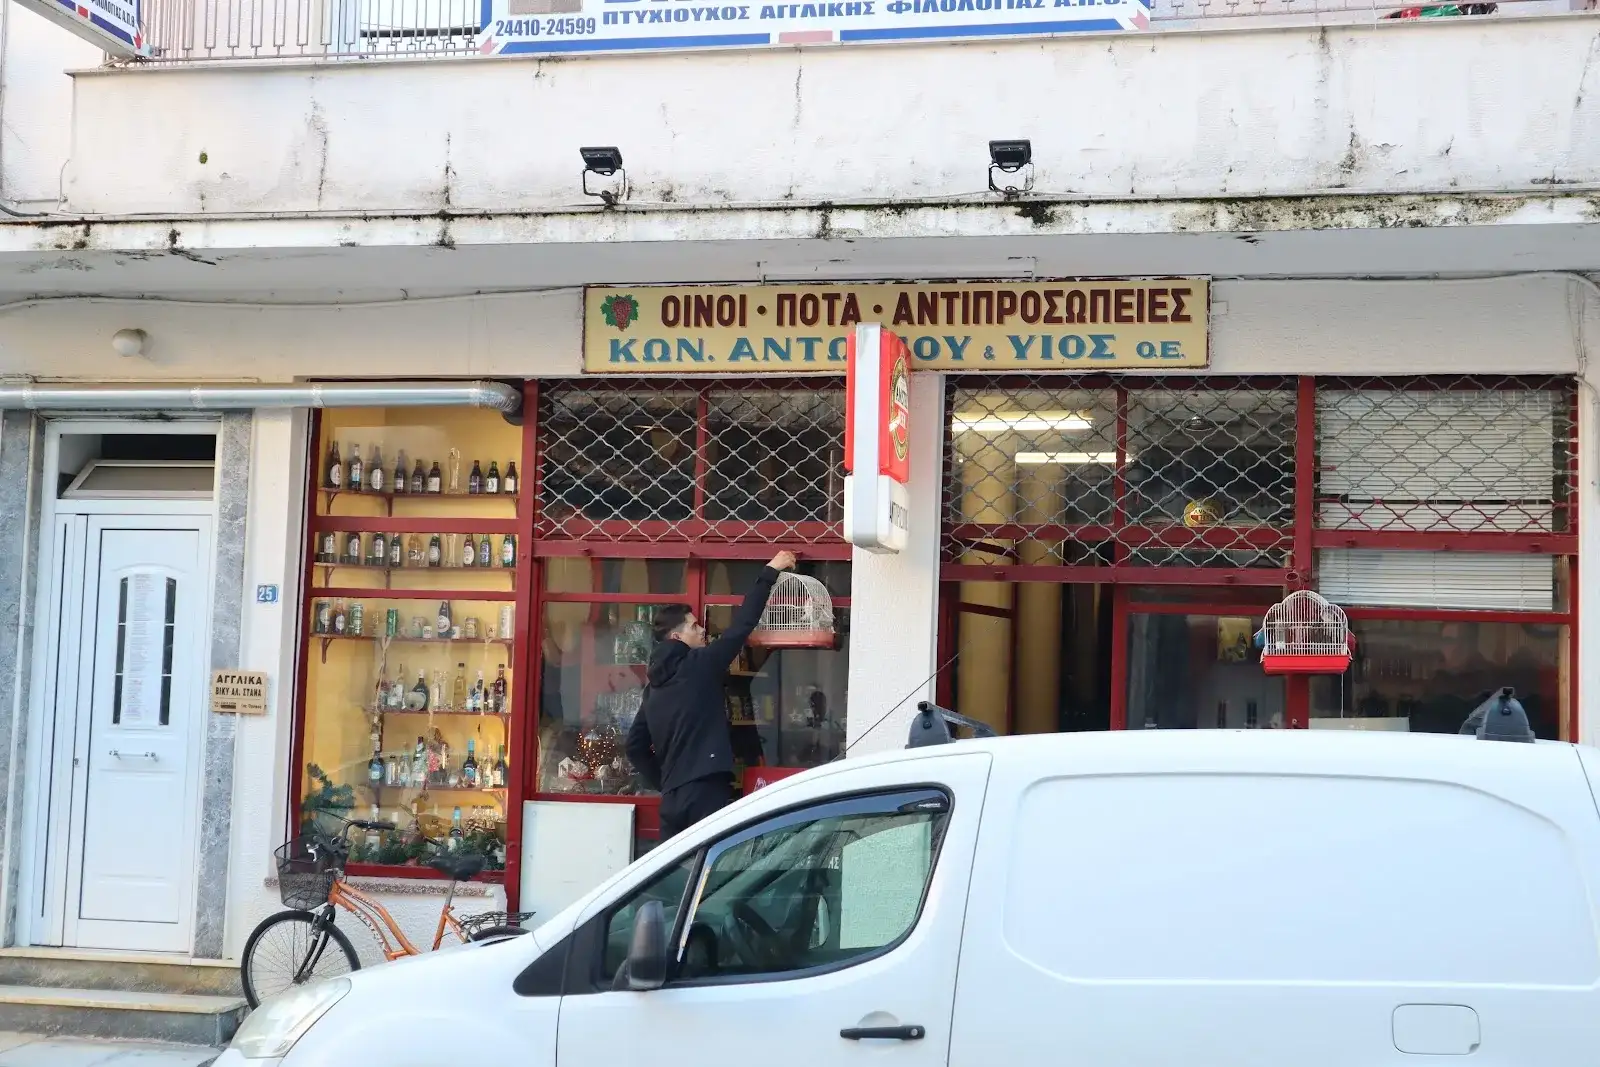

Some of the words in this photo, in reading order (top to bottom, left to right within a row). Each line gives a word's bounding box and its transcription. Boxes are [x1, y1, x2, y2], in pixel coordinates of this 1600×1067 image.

[602, 6, 750, 25] ΠΤΥΧΙΟΥΧΟΣ
[759, 1, 875, 20] ΑΓΓΛΙΚΗΣ
[495, 18, 596, 36] 24410-24599
[661, 293, 747, 328] ΟΙΝΟΙ
[776, 292, 862, 327] ΠΟΤΑ
[892, 288, 1191, 325] ΑΝΤΙΠΡΟΣΩΠΕΙΕΣ
[608, 337, 715, 363] ΚΩΝ.
[727, 335, 972, 362] ΑΝΤΩΟΥ
[983, 344, 996, 360] &
[1007, 334, 1117, 361] ΥΙΟΣ
[258, 586, 273, 601] 25
[216, 674, 262, 685] ΑΓΓΛΙΚΑ
